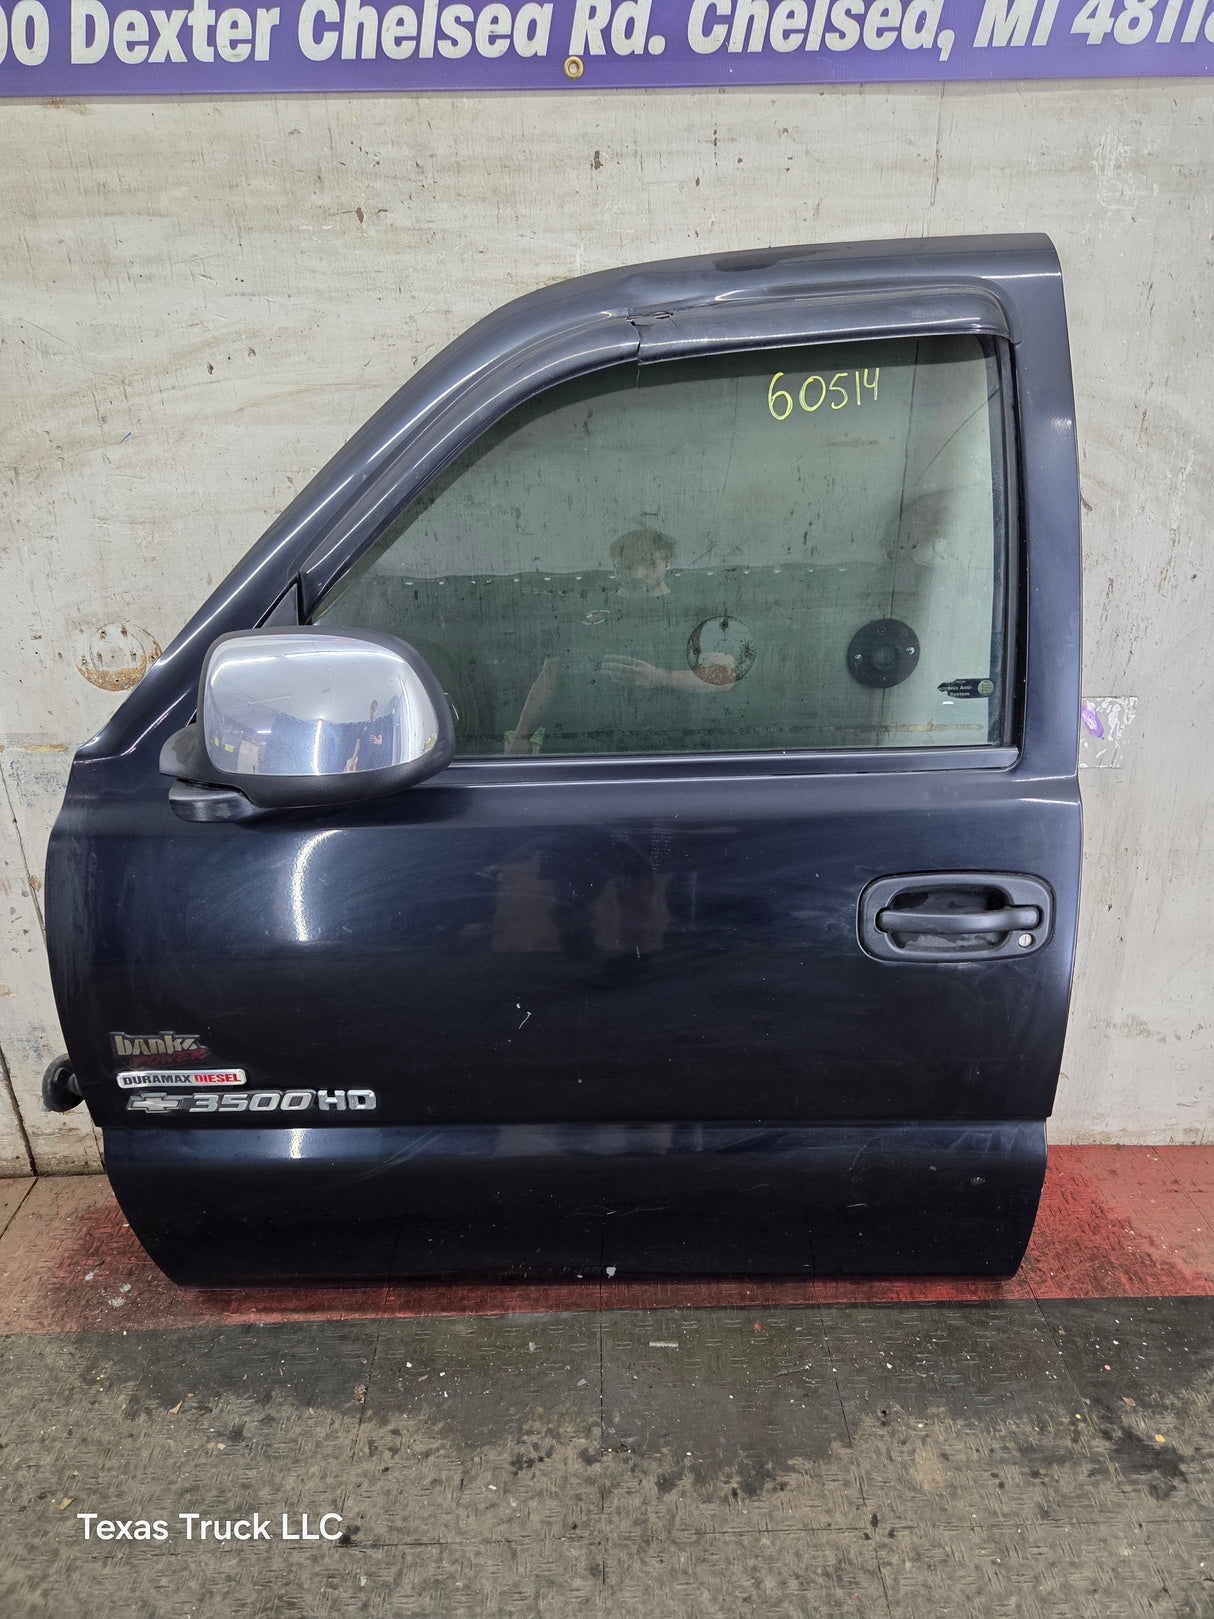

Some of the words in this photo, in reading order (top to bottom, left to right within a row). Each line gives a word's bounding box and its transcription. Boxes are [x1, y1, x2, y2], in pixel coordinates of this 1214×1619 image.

[0, 0, 50, 66] 0
[70, 0, 281, 65] Dexter
[298, 0, 554, 61] Chelsea
[568, 0, 666, 56] Rd.
[687, 0, 955, 62] Chelsea,
[973, 0, 1060, 48] MI
[1070, 0, 1214, 45] 4811
[768, 367, 880, 420] 60514
[122, 1074, 192, 1085] DURAMAX
[194, 1073, 241, 1084] DIESEL
